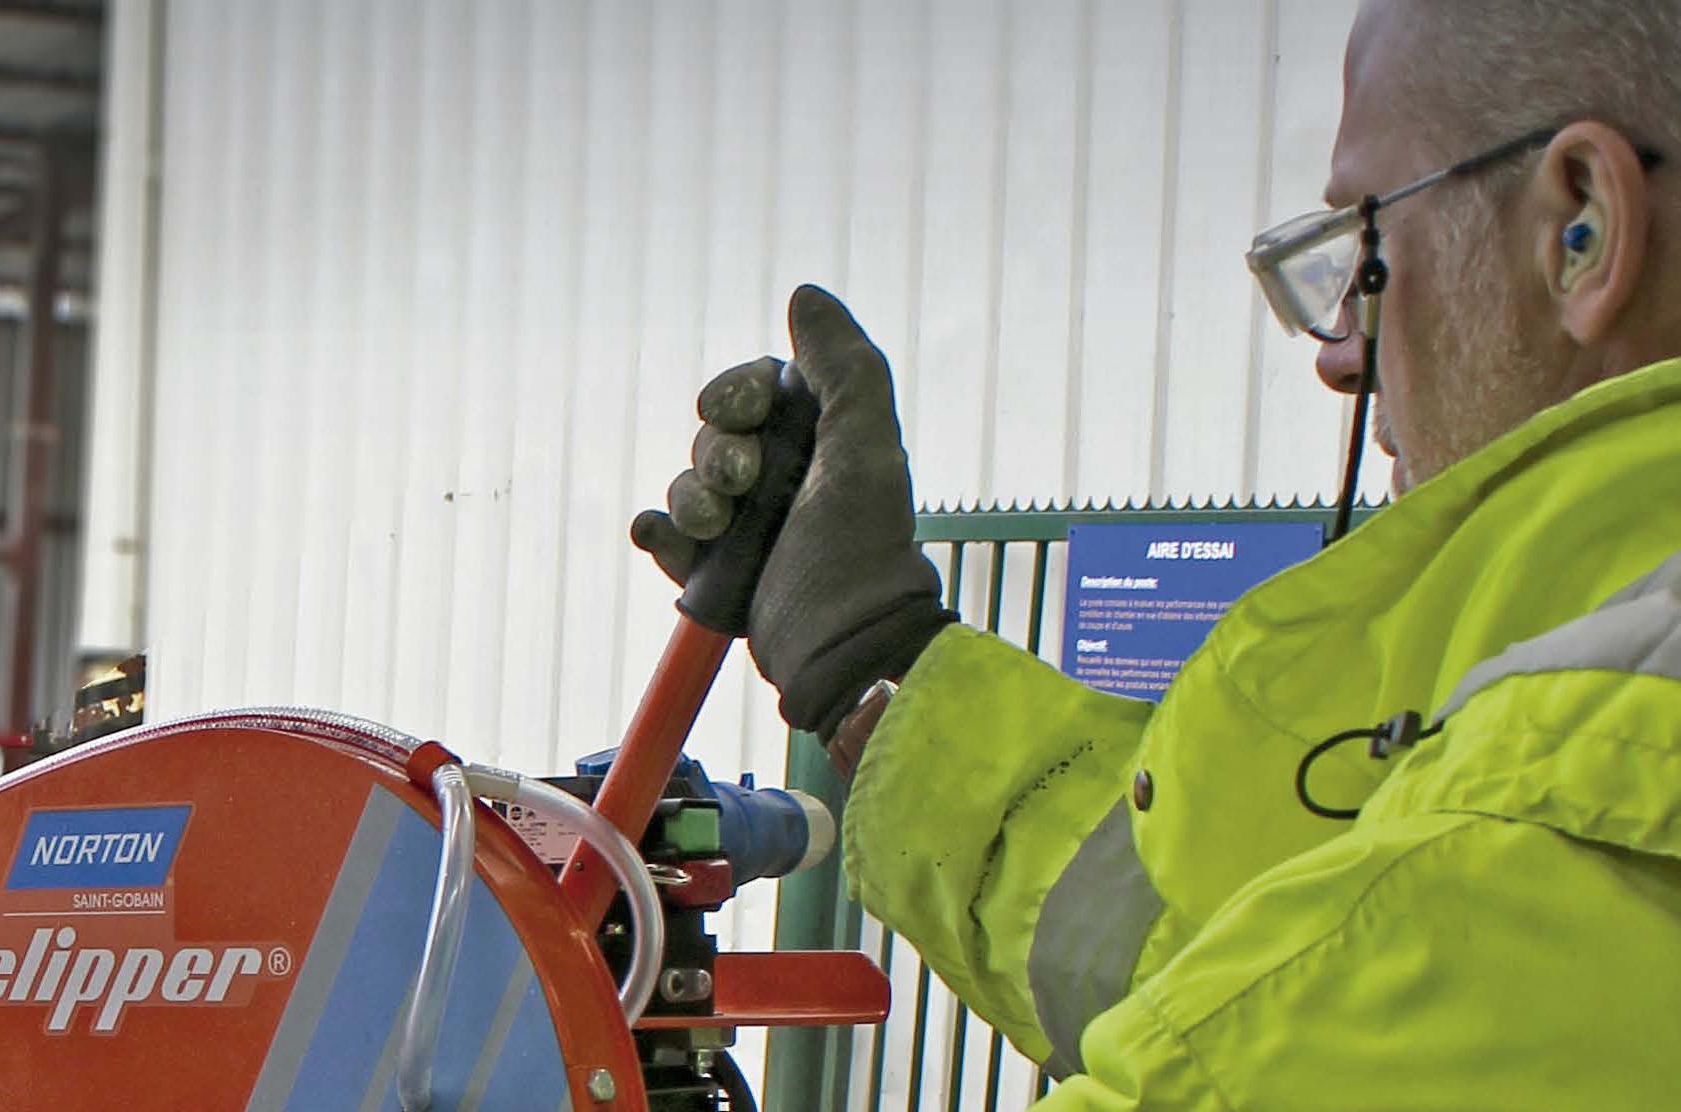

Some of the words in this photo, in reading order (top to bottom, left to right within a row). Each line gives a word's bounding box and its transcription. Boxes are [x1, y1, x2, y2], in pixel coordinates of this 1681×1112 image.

[1146, 541, 1179, 559] AIRE
[1180, 541, 1234, 559] D'ESSAI
[30, 832, 164, 865] NORTON
[72, 891, 165, 909] SAINT-GOBAIN
